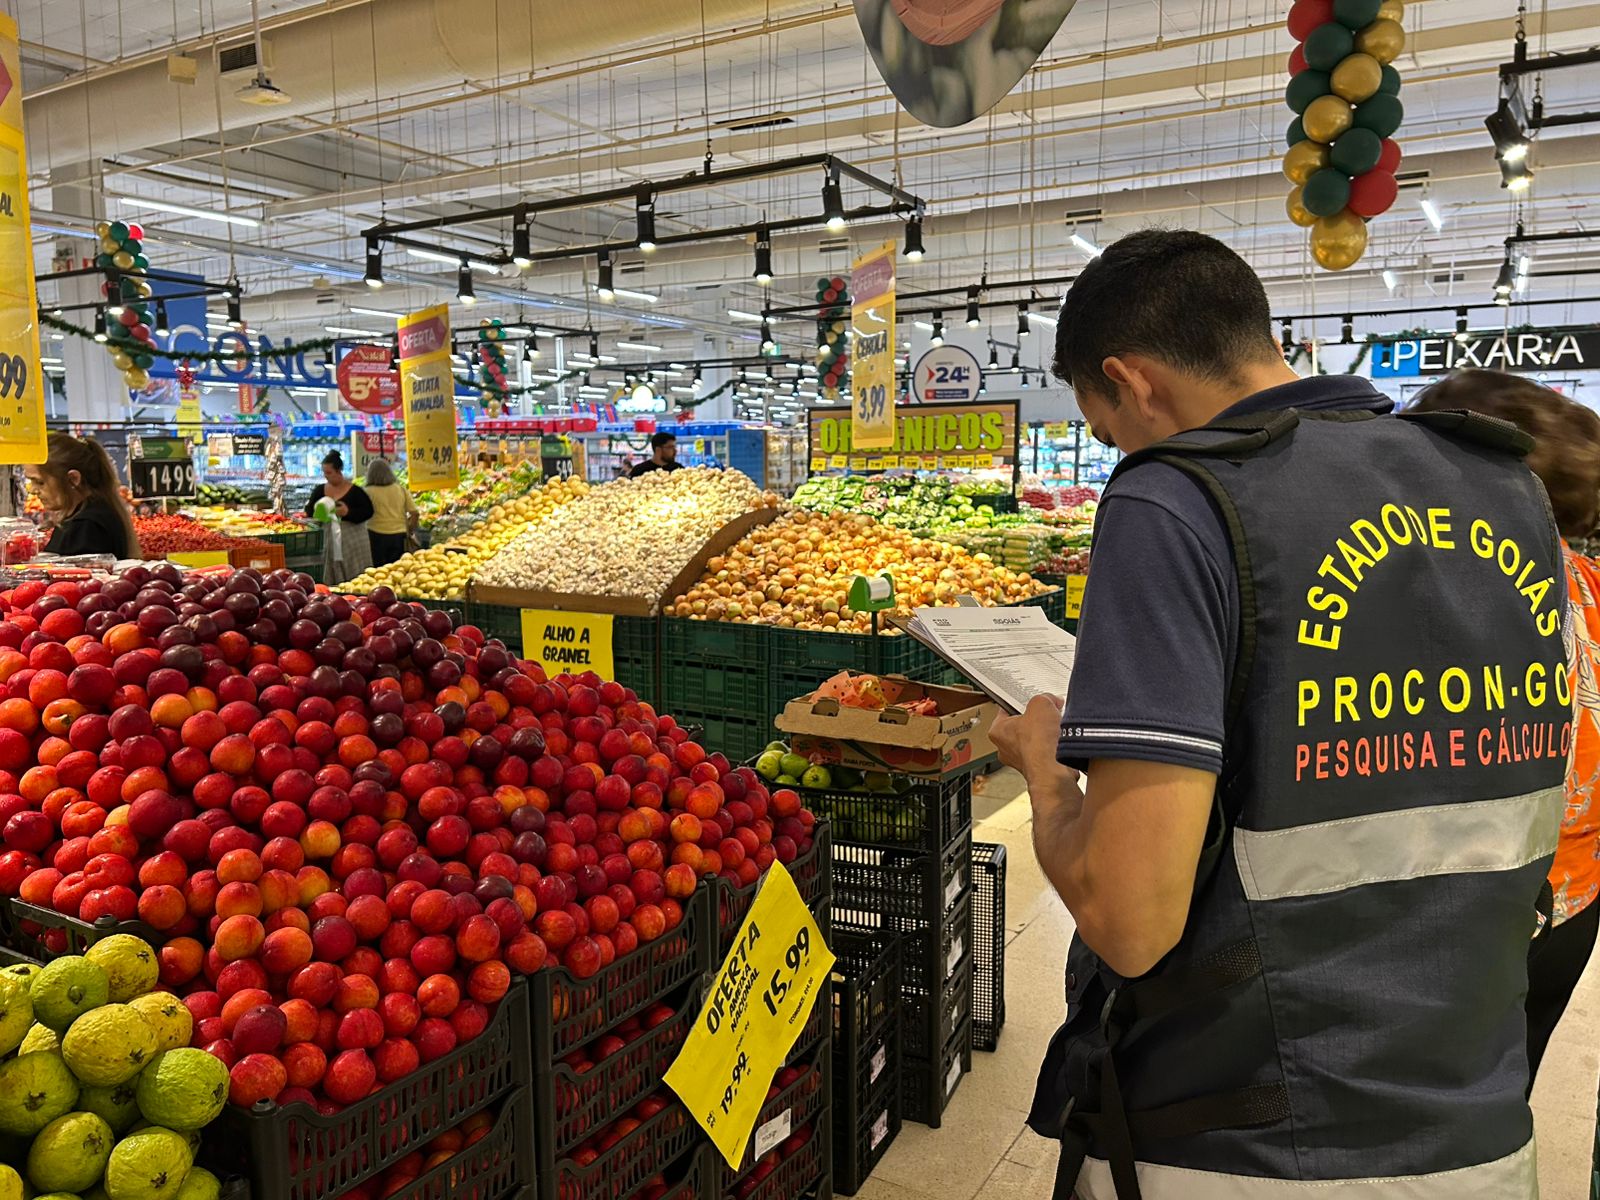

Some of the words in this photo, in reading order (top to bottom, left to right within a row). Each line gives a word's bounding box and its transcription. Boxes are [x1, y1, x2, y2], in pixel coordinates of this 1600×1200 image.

[401, 328, 436, 350] OFERTA
[1393, 334, 1584, 370] PEIXARA
[412, 376, 440, 395] BATATA
[859, 384, 884, 422] 3,99
[820, 412, 1004, 453] ORNICOS
[432, 445, 453, 467] 4,99
[1470, 519, 1561, 637] GOIÁS
[543, 625, 575, 643] ALHO
[580, 628, 590, 643] A
[542, 646, 591, 664] GRANEL
[1296, 730, 1438, 781] PESQUISA
[1449, 729, 1466, 767] E
[1477, 718, 1571, 765] CÁLCULO
[706, 921, 761, 1035] OFERTA
[729, 963, 751, 1019] AMEIXA
[763, 926, 810, 1017] 15,99
[730, 968, 760, 1032] NACIONAL
[720, 1051, 747, 1114] 19,99
